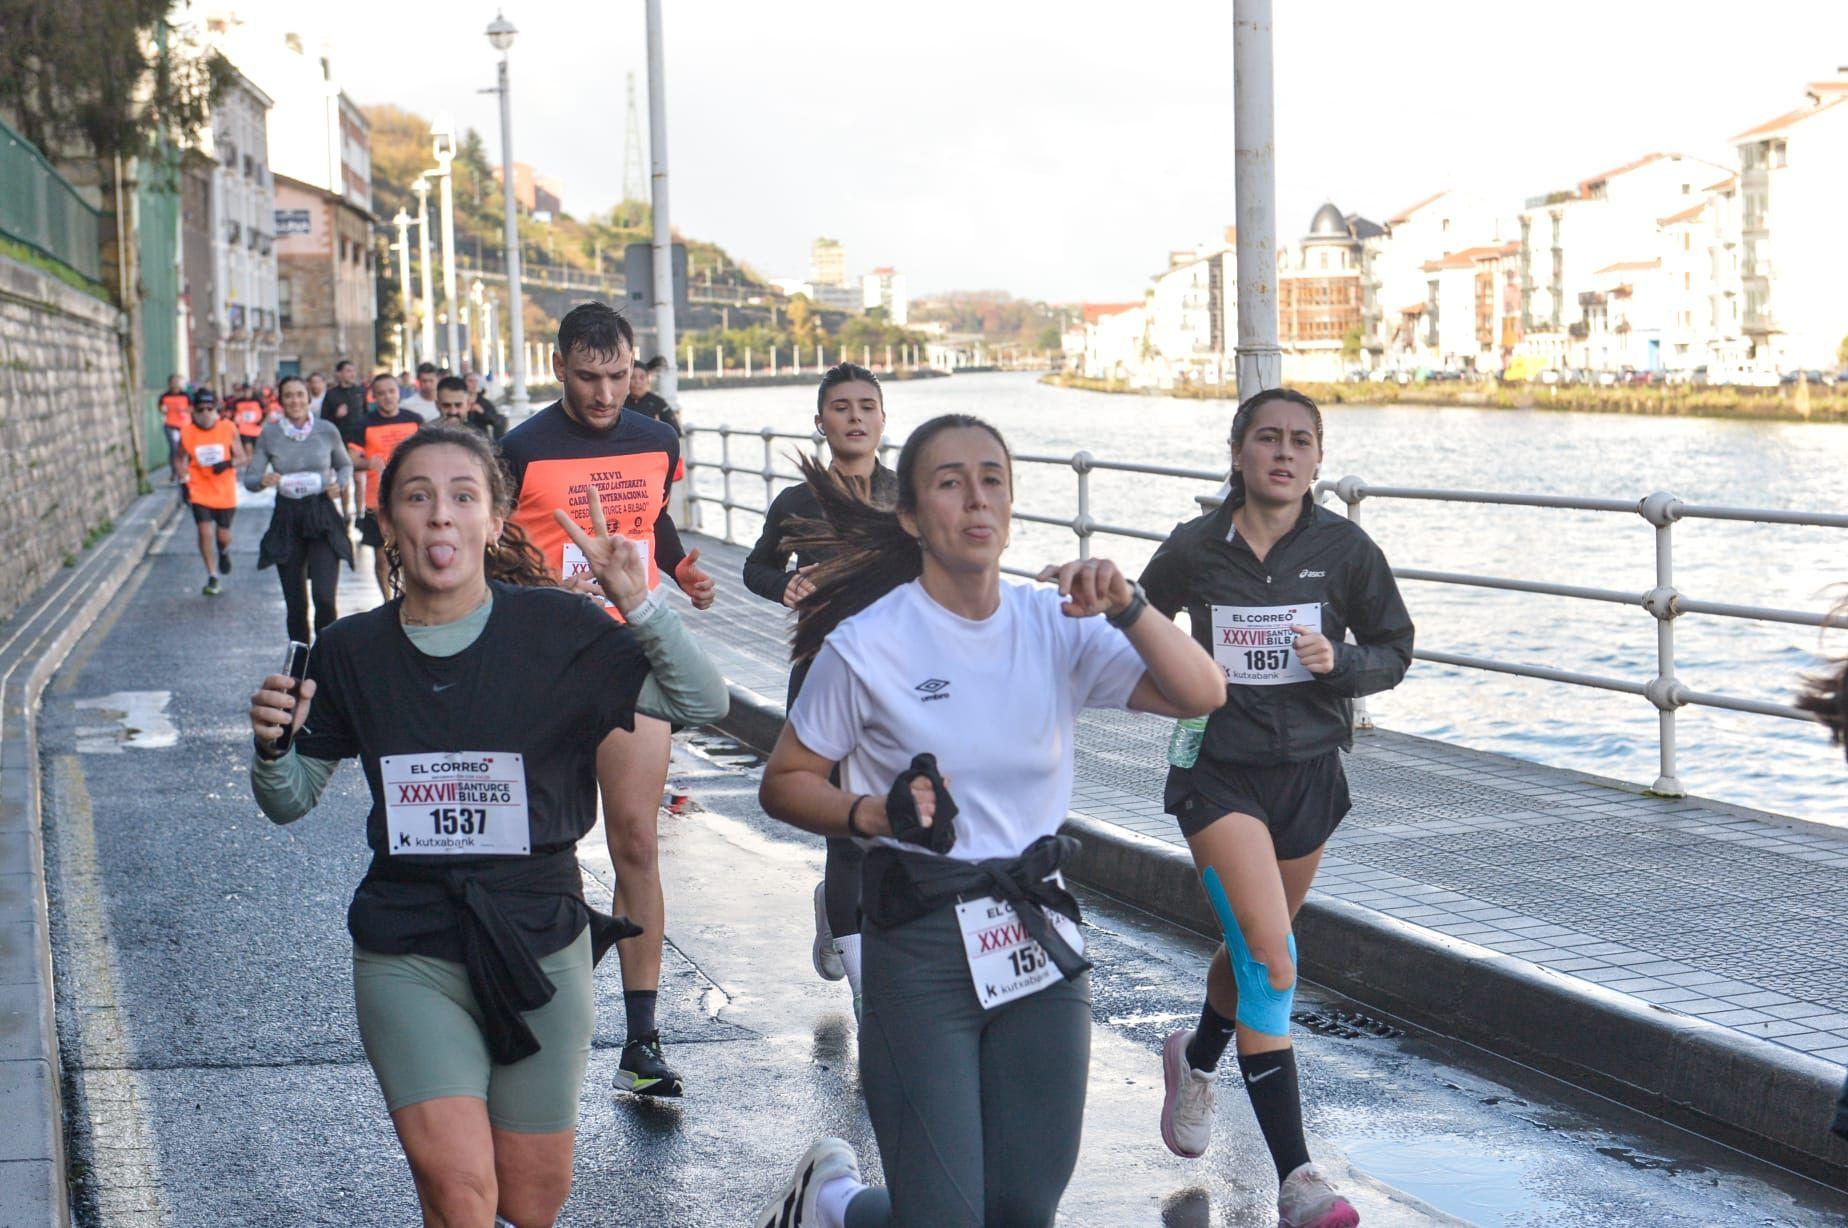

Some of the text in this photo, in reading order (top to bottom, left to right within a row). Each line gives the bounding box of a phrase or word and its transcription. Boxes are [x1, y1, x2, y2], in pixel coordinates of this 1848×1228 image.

[590, 471, 622, 481] XXXVII
[611, 479, 646, 490] LASTERKETA
[600, 490, 648, 502] INTERNACIONAL
[1232, 613, 1293, 623] EL CORREO
[1223, 629, 1264, 646] XXXVII
[1266, 629, 1295, 637] SANTU
[1244, 649, 1289, 670] 1857
[1233, 671, 1279, 680] kutxabank
[411, 762, 489, 774] EL CORREO
[399, 783, 456, 803] XXXVII
[458, 782, 510, 792] SANTURCE
[458, 791, 511, 803] BILBAO
[429, 808, 487, 835] 1537
[416, 837, 474, 848] kutxabank
[986, 907, 1003, 919] EL
